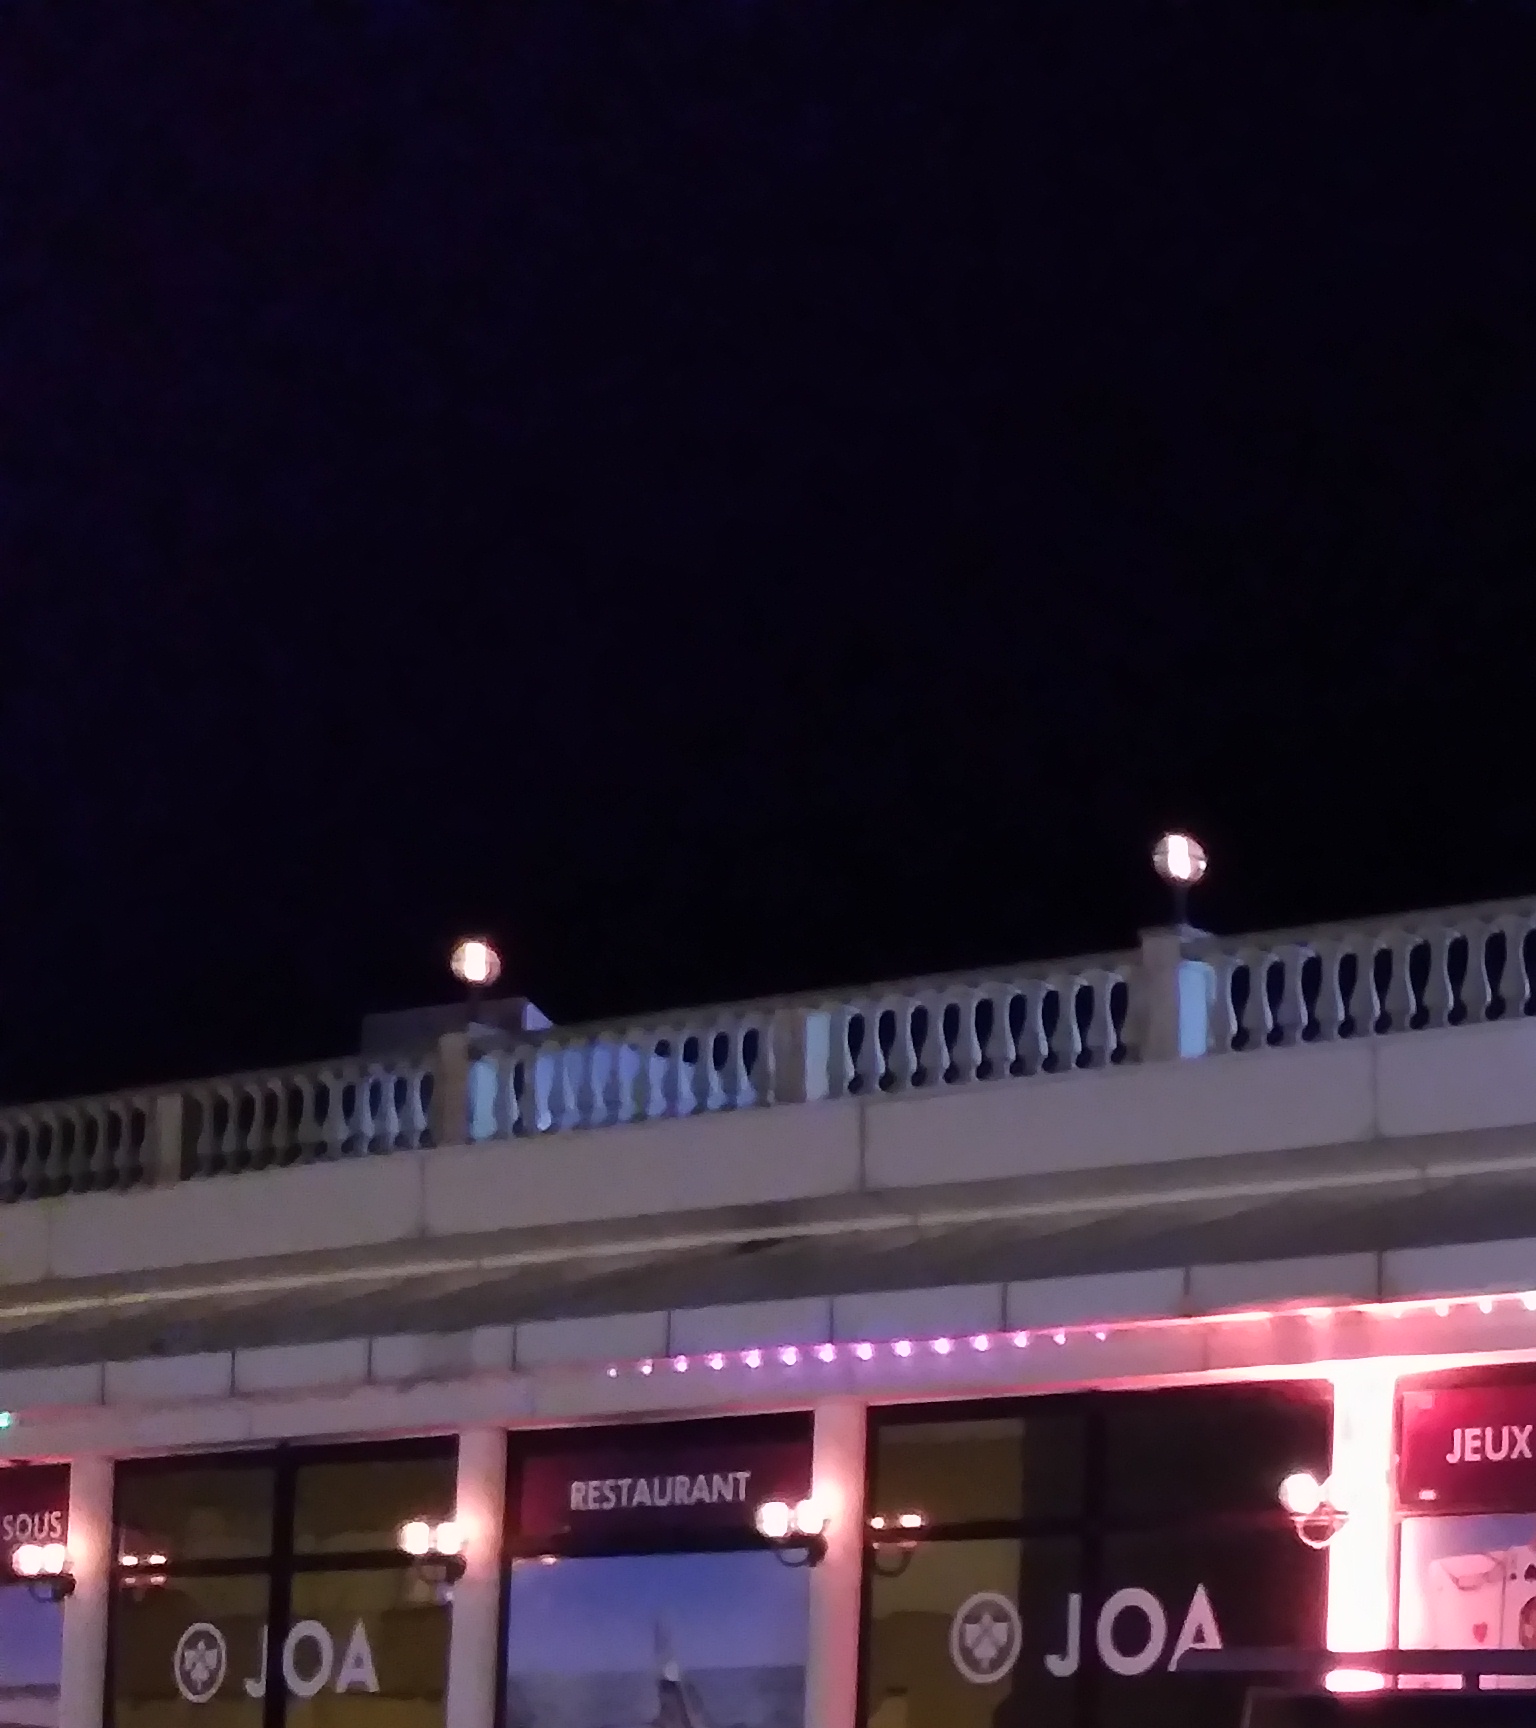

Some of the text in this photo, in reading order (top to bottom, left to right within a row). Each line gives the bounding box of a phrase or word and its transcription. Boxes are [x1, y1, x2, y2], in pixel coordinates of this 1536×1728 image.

[1445, 1424, 1534, 1465] JEUX
[570, 1470, 752, 1512] RESTAURANT
[2, 1510, 62, 1541] SOUS
[1043, 1583, 1225, 1677] JOA
[244, 1618, 380, 1699] JOA
